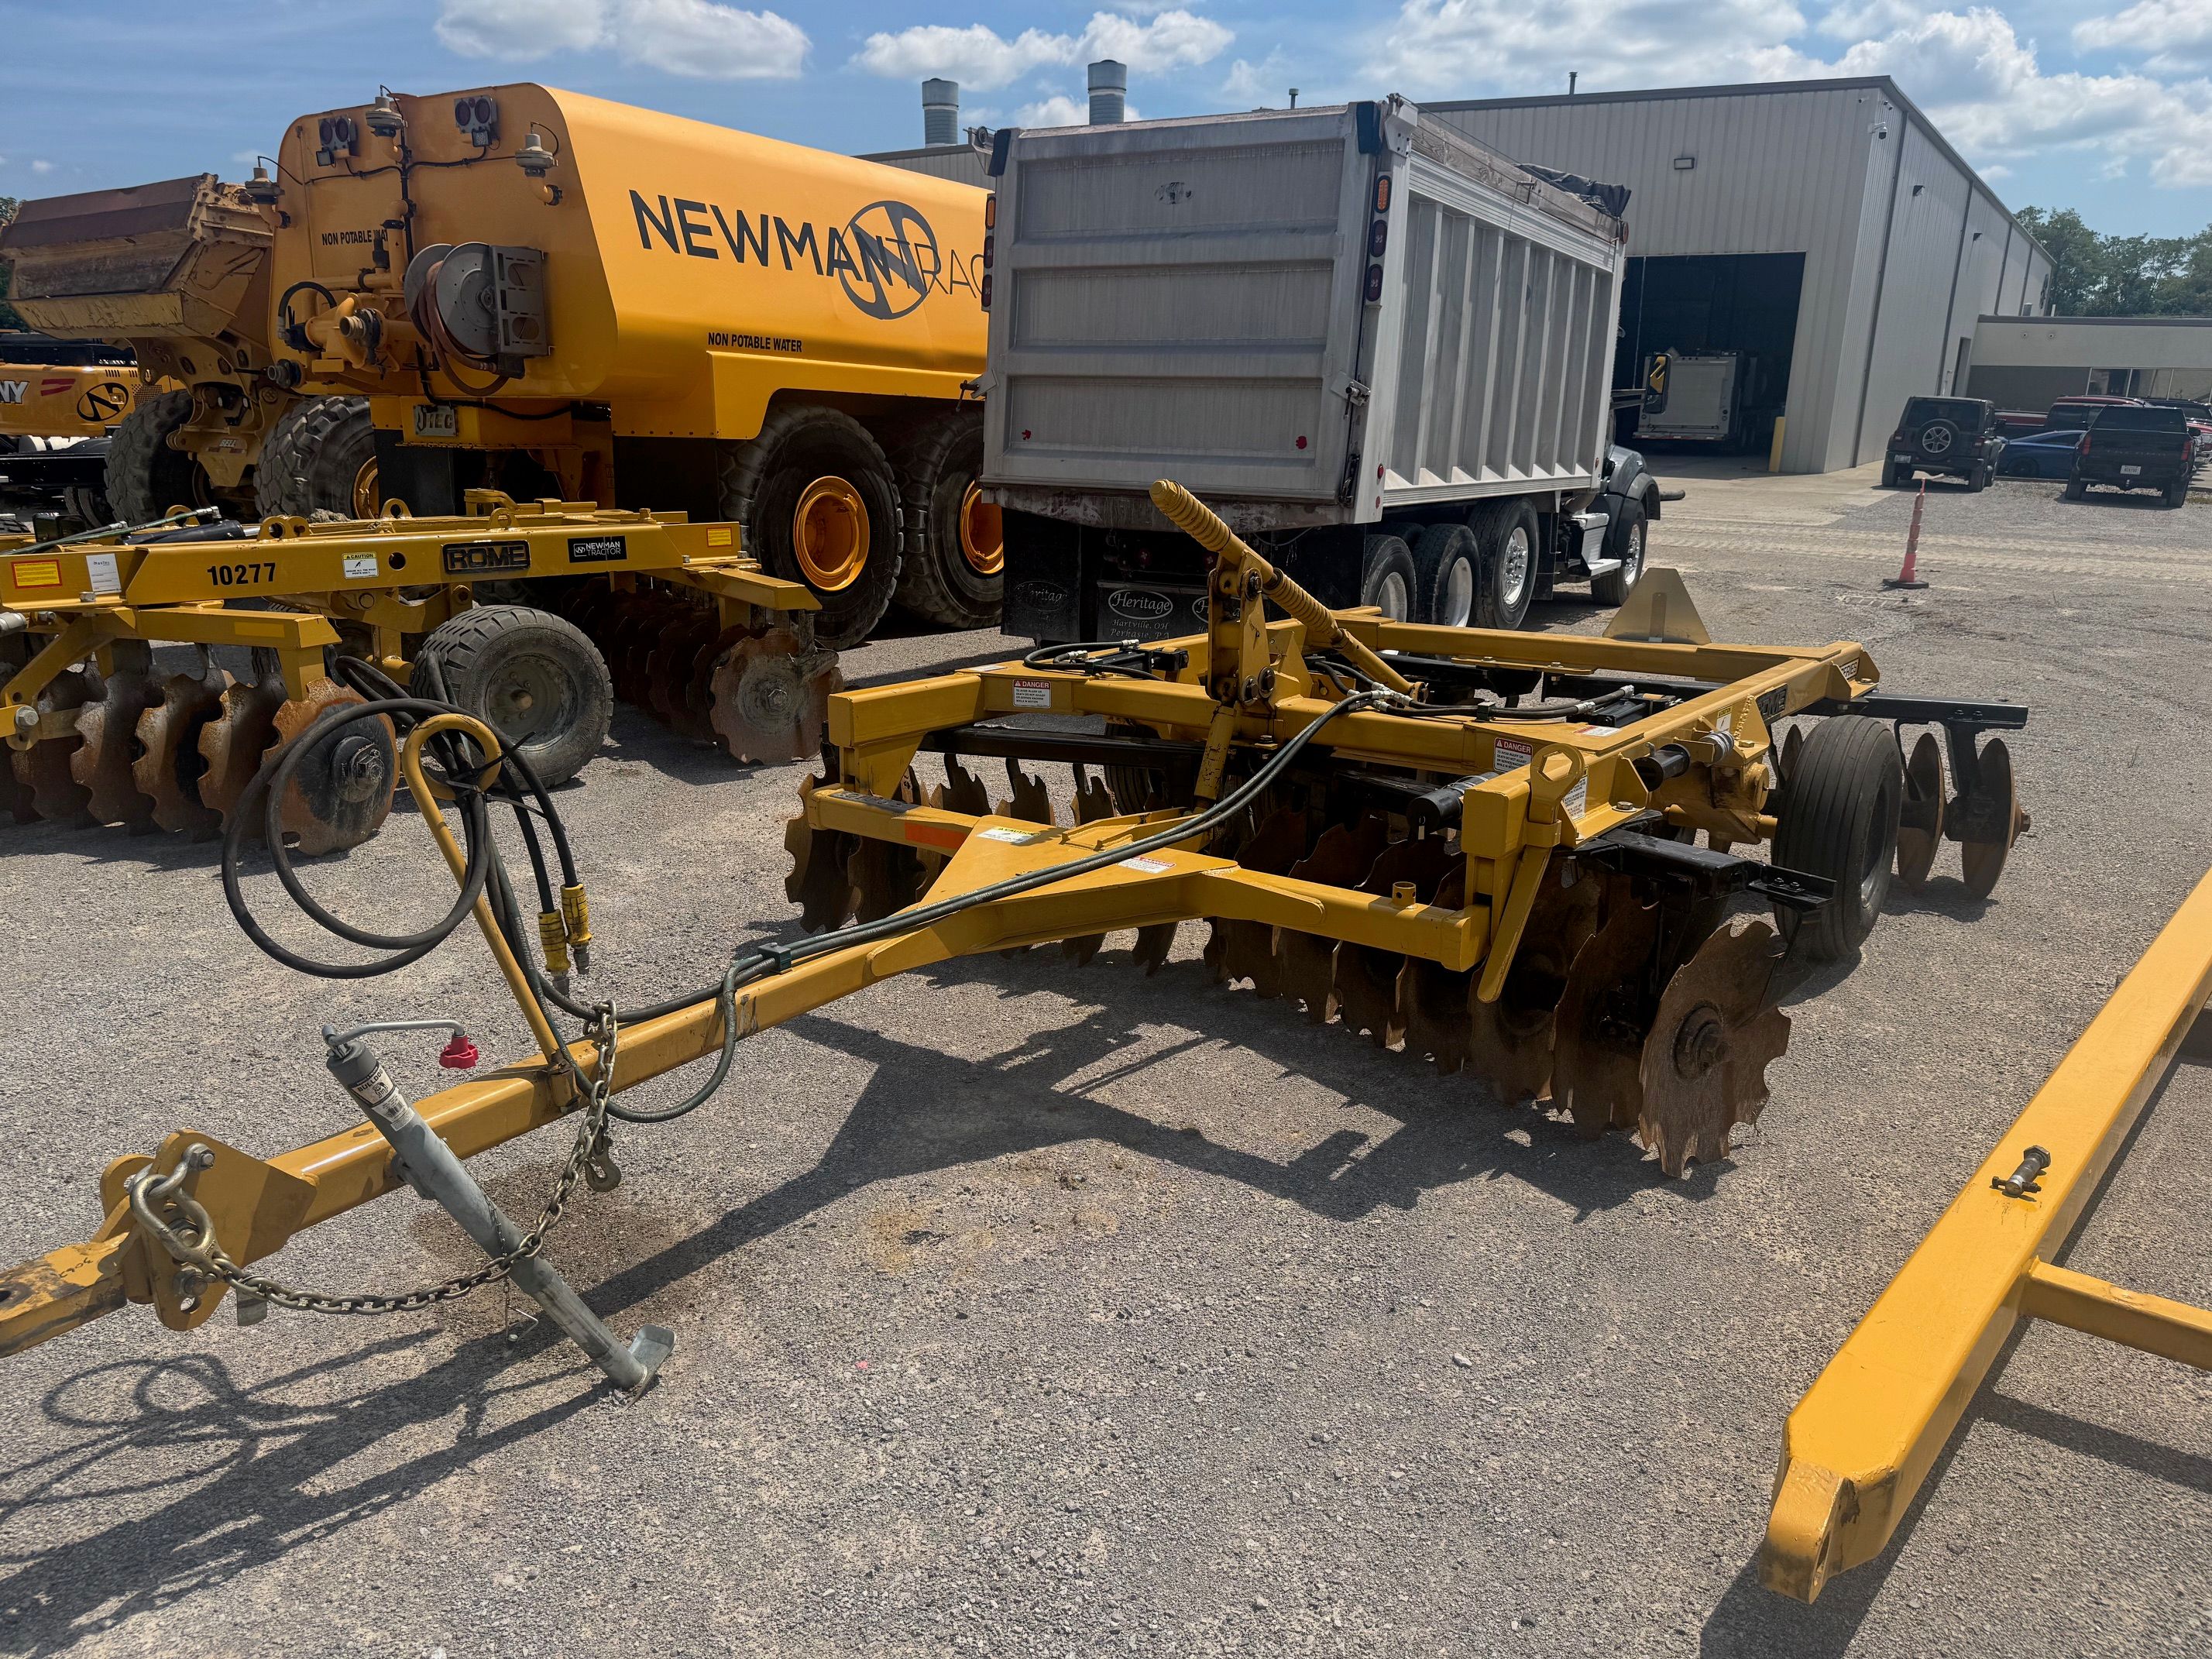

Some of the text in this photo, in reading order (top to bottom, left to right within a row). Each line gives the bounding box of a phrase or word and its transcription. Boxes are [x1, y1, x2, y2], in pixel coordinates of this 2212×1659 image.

[322, 232, 338, 246] NON
[341, 230, 372, 245] POTABLE
[629, 189, 893, 287] NEWMAN
[708, 332, 802, 352] NON POTABLE WATER
[586, 541, 620, 550] NEWMAN
[447, 545, 527, 570] ROME
[207, 562, 276, 586] 10277
[1112, 592, 1170, 614] Heritage
[1758, 689, 1785, 718] OME
[1503, 741, 1530, 753] DANGER
[514, 917, 534, 967] Weatherhead
[357, 1069, 383, 1092] BULLDOG
